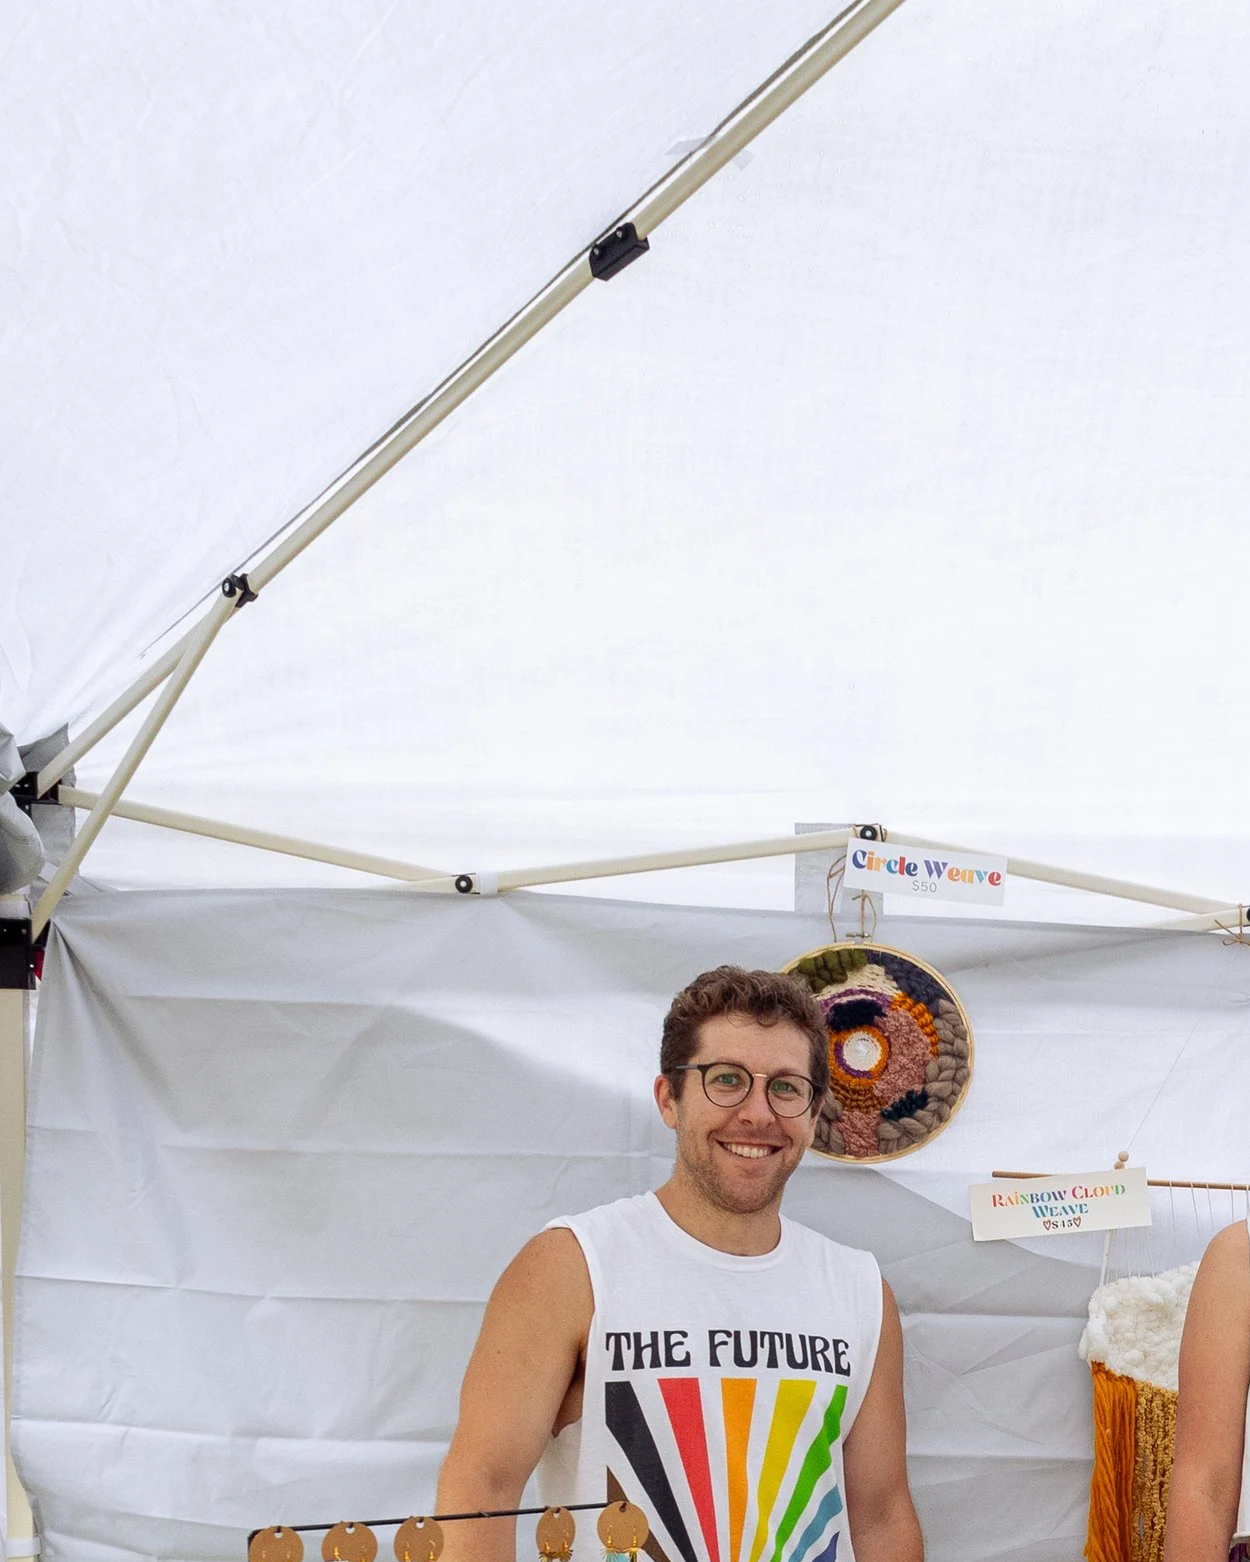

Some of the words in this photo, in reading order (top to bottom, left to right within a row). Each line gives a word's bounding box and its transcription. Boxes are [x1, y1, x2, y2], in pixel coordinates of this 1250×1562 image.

[852, 849, 919, 877] Circle
[924, 859, 1002, 886] Weave
[912, 880, 937, 893] $50
[1072, 1184, 1126, 1200] CLOUD
[1032, 1203, 1089, 1219] WEAVE
[605, 1330, 691, 1371] THE
[708, 1329, 851, 1377] FUTURE
